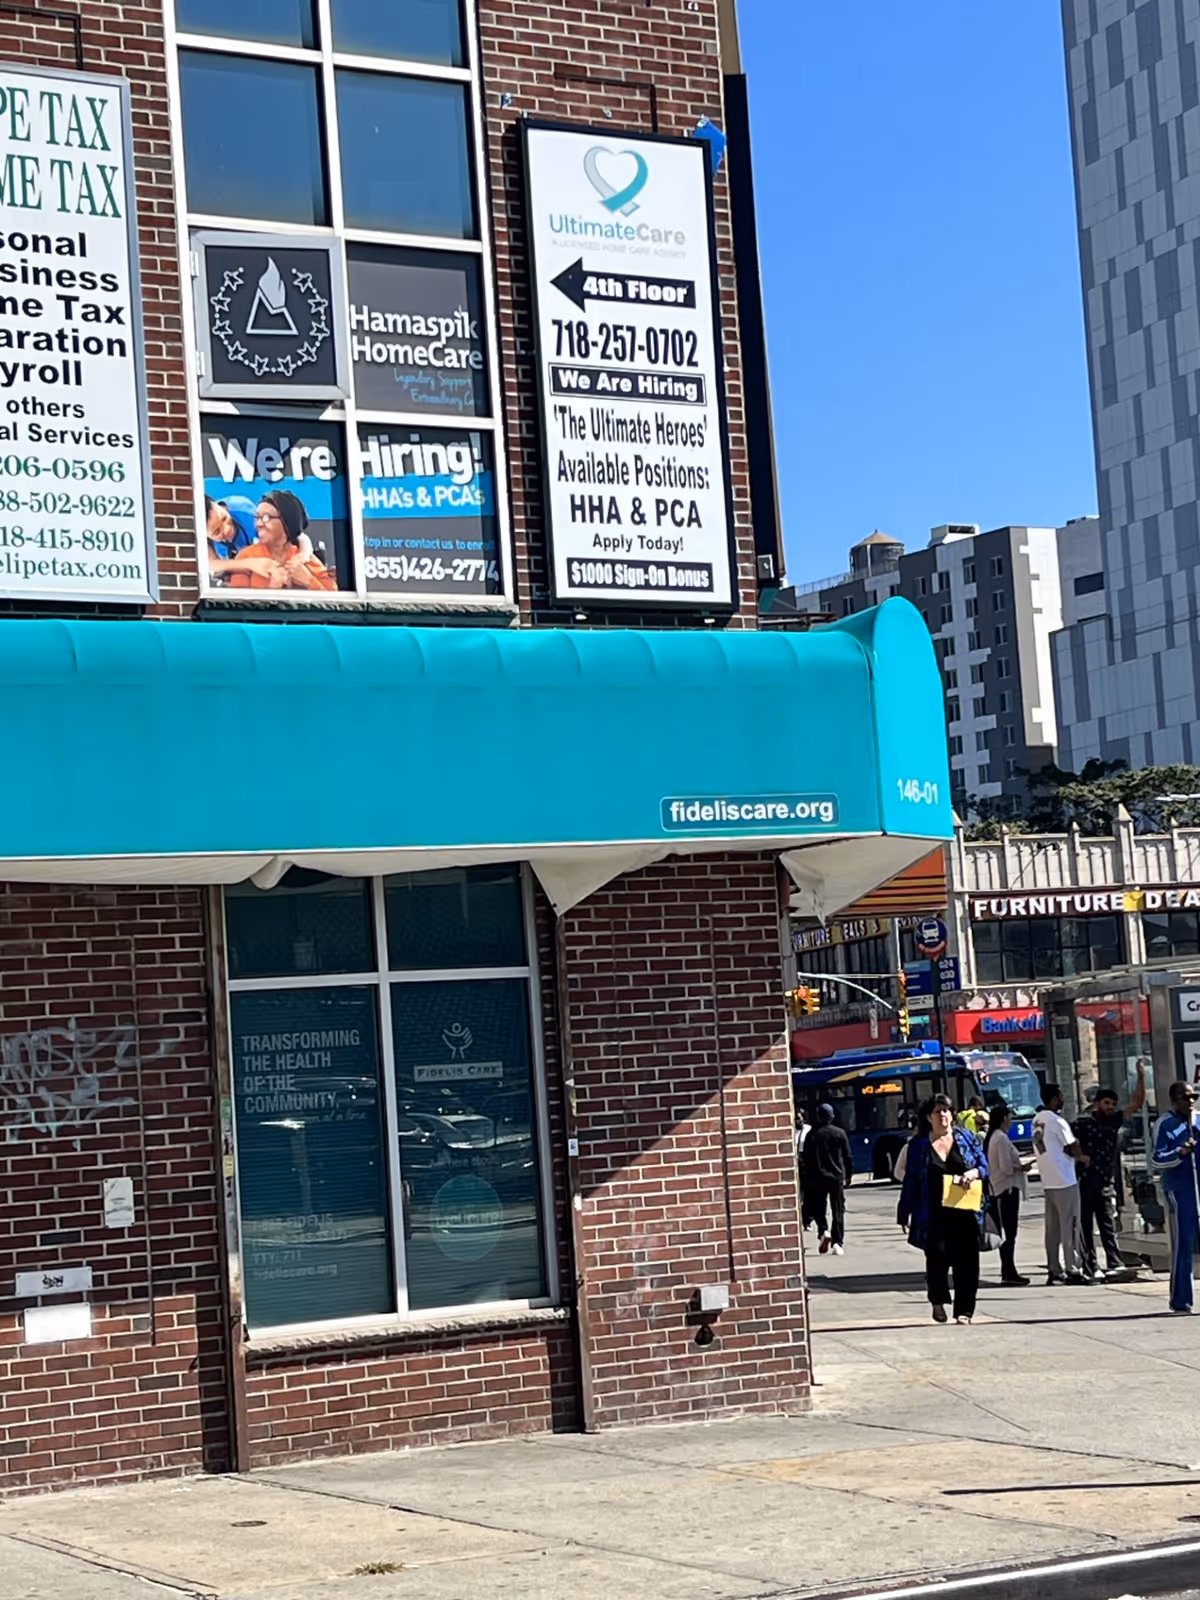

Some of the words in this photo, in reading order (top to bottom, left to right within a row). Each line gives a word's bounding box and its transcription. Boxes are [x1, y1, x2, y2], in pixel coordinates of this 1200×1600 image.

[40, 90, 111, 151] TAX
[50, 158, 122, 219] TAX
[549, 213, 686, 245] UltimateCare
[583, 275, 623, 299] 4th
[625, 279, 689, 304] Floor
[56, 293, 126, 326] Tax
[349, 303, 479, 345] Hamaspik
[352, 334, 483, 370] HomeCare
[551, 318, 699, 368] 718-257-0702
[0, 359, 82, 388] yroll
[558, 369, 591, 389] We
[596, 372, 632, 393] Are
[637, 376, 698, 401] Hiring
[6, 396, 85, 419] others
[28, 422, 135, 449] Services
[590, 407, 651, 445] Ultimate
[0, 454, 126, 483] 06-0596
[208, 437, 337, 484] We're
[360, 432, 485, 485] Hiring!
[558, 449, 630, 486] Available
[634, 453, 710, 490] Positions:
[416, 486, 433, 508] &
[434, 485, 486, 508] PCA's
[569, 493, 622, 525] HHA
[630, 496, 647, 526] &
[655, 497, 703, 529] PCA
[0, 525, 134, 553] 18-415-8910
[592, 532, 633, 553] Apply
[637, 534, 685, 555] Today!
[571, 561, 613, 585] $1000
[614, 564, 666, 588] Sign-On
[667, 566, 710, 589] Bonus
[897, 778, 939, 806] 146-01
[669, 800, 834, 823] fideliscare.org
[974, 892, 1124, 919] FURNITURE
[241, 1029, 360, 1052] TRANSFORMING
[242, 1055, 272, 1072] THE
[275, 1052, 331, 1071] HEALTH
[244, 1076, 264, 1093] OF
[265, 1074, 296, 1091] THE
[244, 1091, 340, 1114] COMMUNITY,
